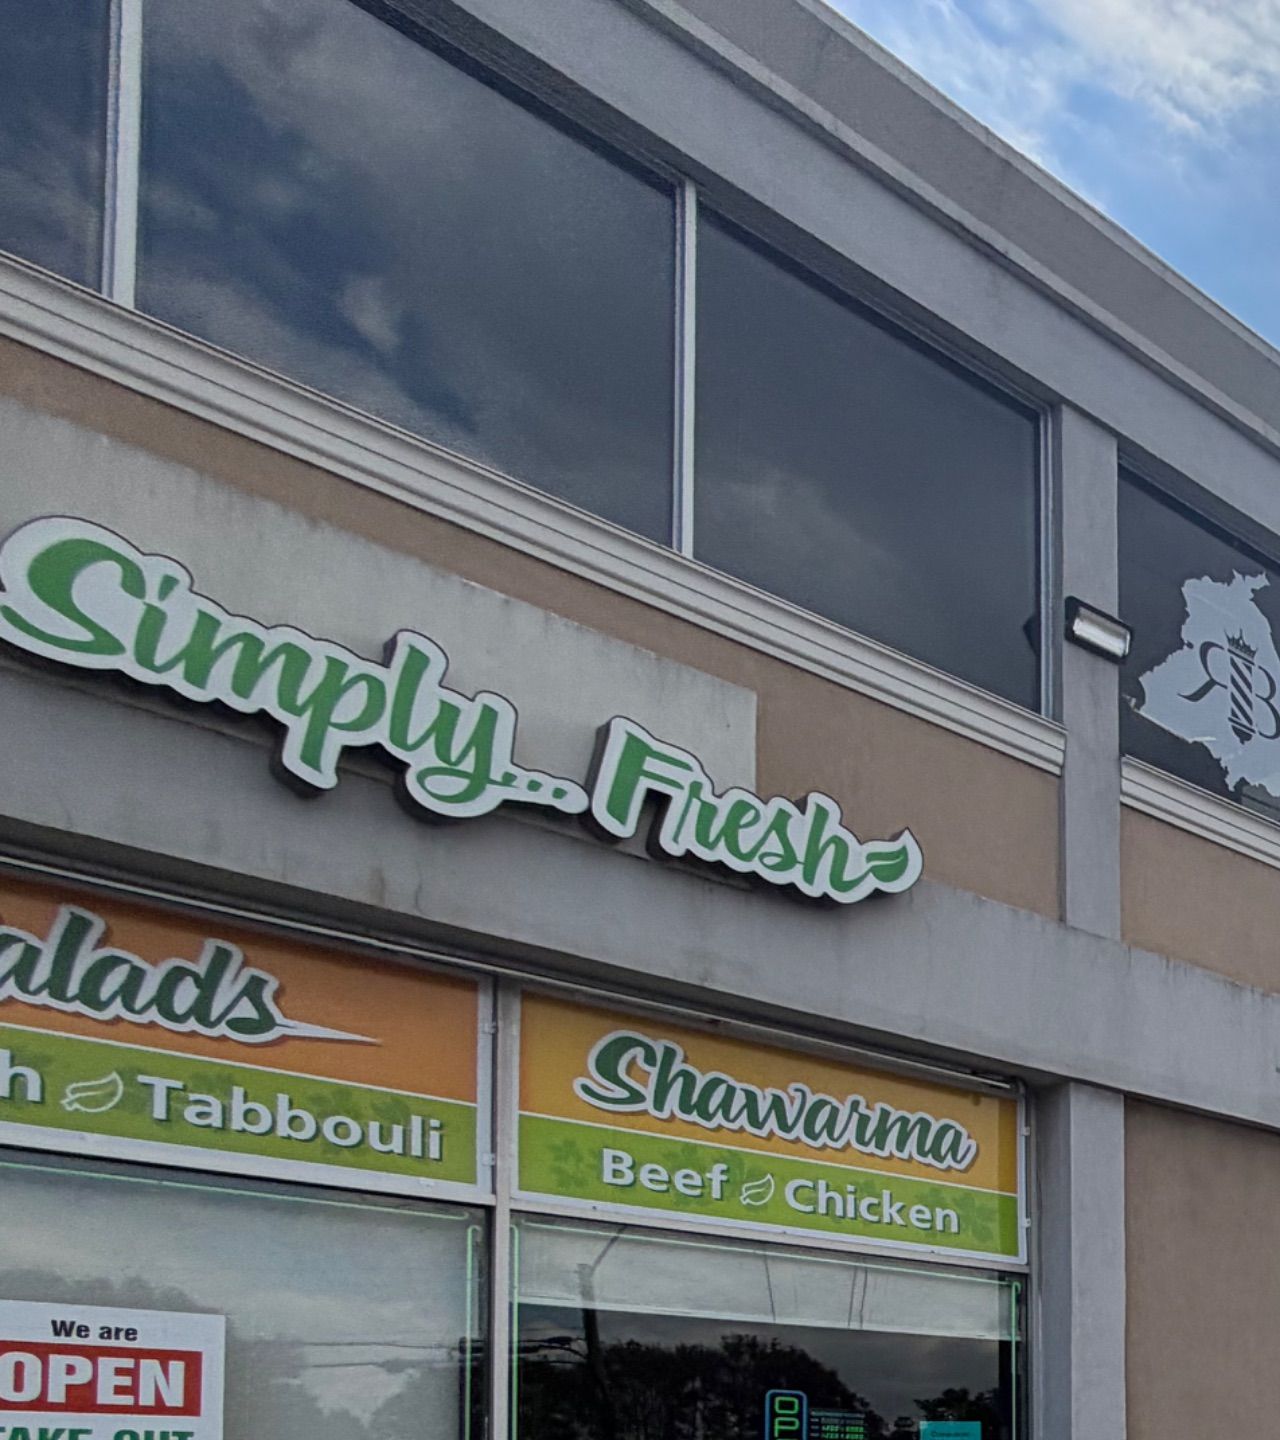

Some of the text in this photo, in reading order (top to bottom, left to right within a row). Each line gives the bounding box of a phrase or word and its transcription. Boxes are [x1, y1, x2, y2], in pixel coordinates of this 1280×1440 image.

[604, 724, 876, 892] Fresh
[137, 1075, 445, 1162] Tabbouli
[580, 1035, 972, 1166] Shawarma
[602, 1147, 960, 1234] Beef Chicken
[51, 1319, 139, 1342] We are
[0, 1351, 186, 1408] OPEN
